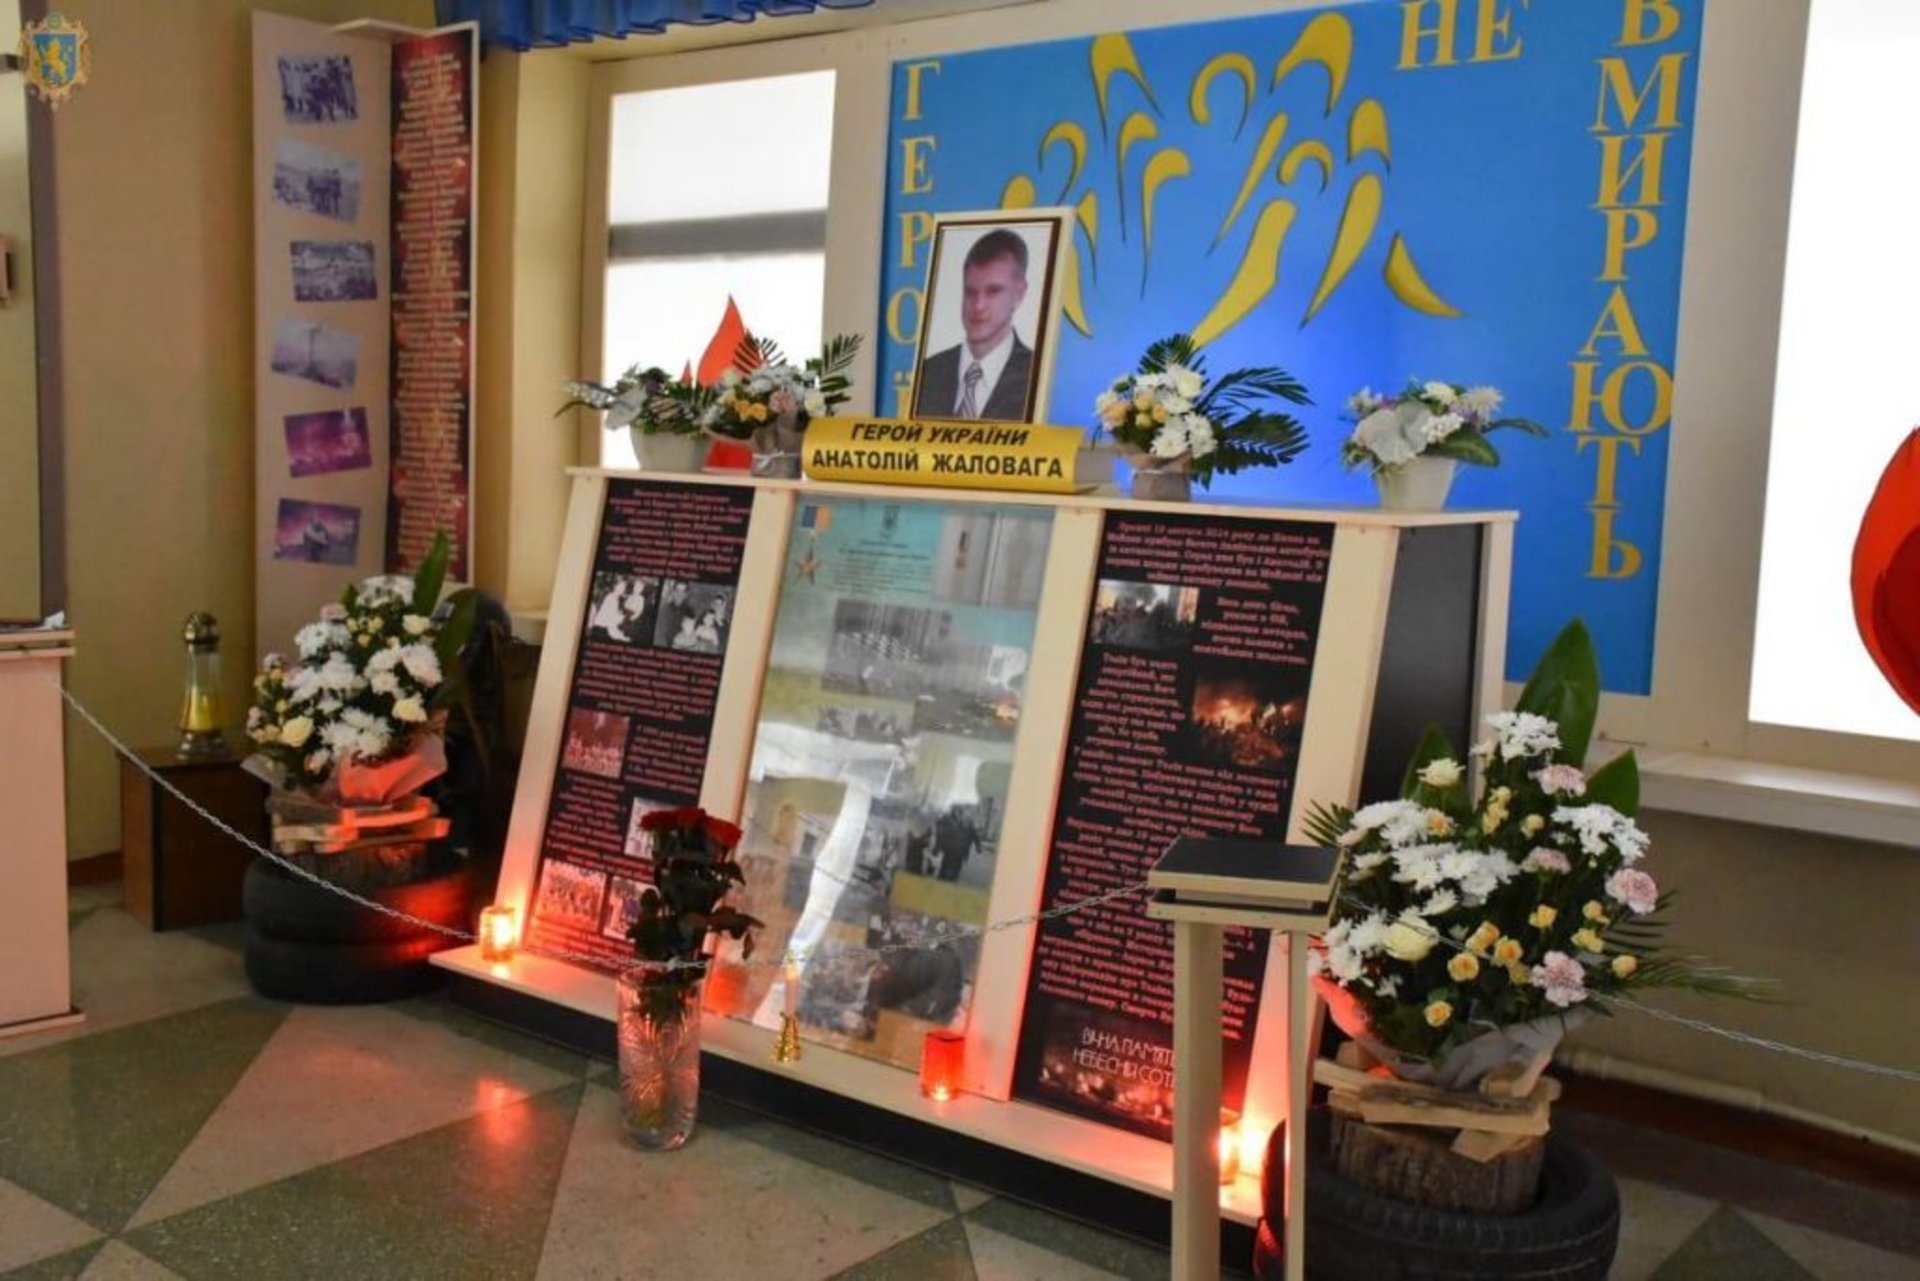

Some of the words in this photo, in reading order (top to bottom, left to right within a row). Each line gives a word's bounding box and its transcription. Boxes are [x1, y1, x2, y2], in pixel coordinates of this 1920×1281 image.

[1394, 0, 1526, 70] НЕ
[1562, 0, 1690, 580] ВМИРАЮТЬ
[851, 423, 923, 443] ГЕРОЙ
[927, 424, 1030, 446] УКРАЇНИ
[811, 448, 919, 471] АНАТОЛІЙ
[932, 453, 1063, 478] ЖАЛОВАГА
